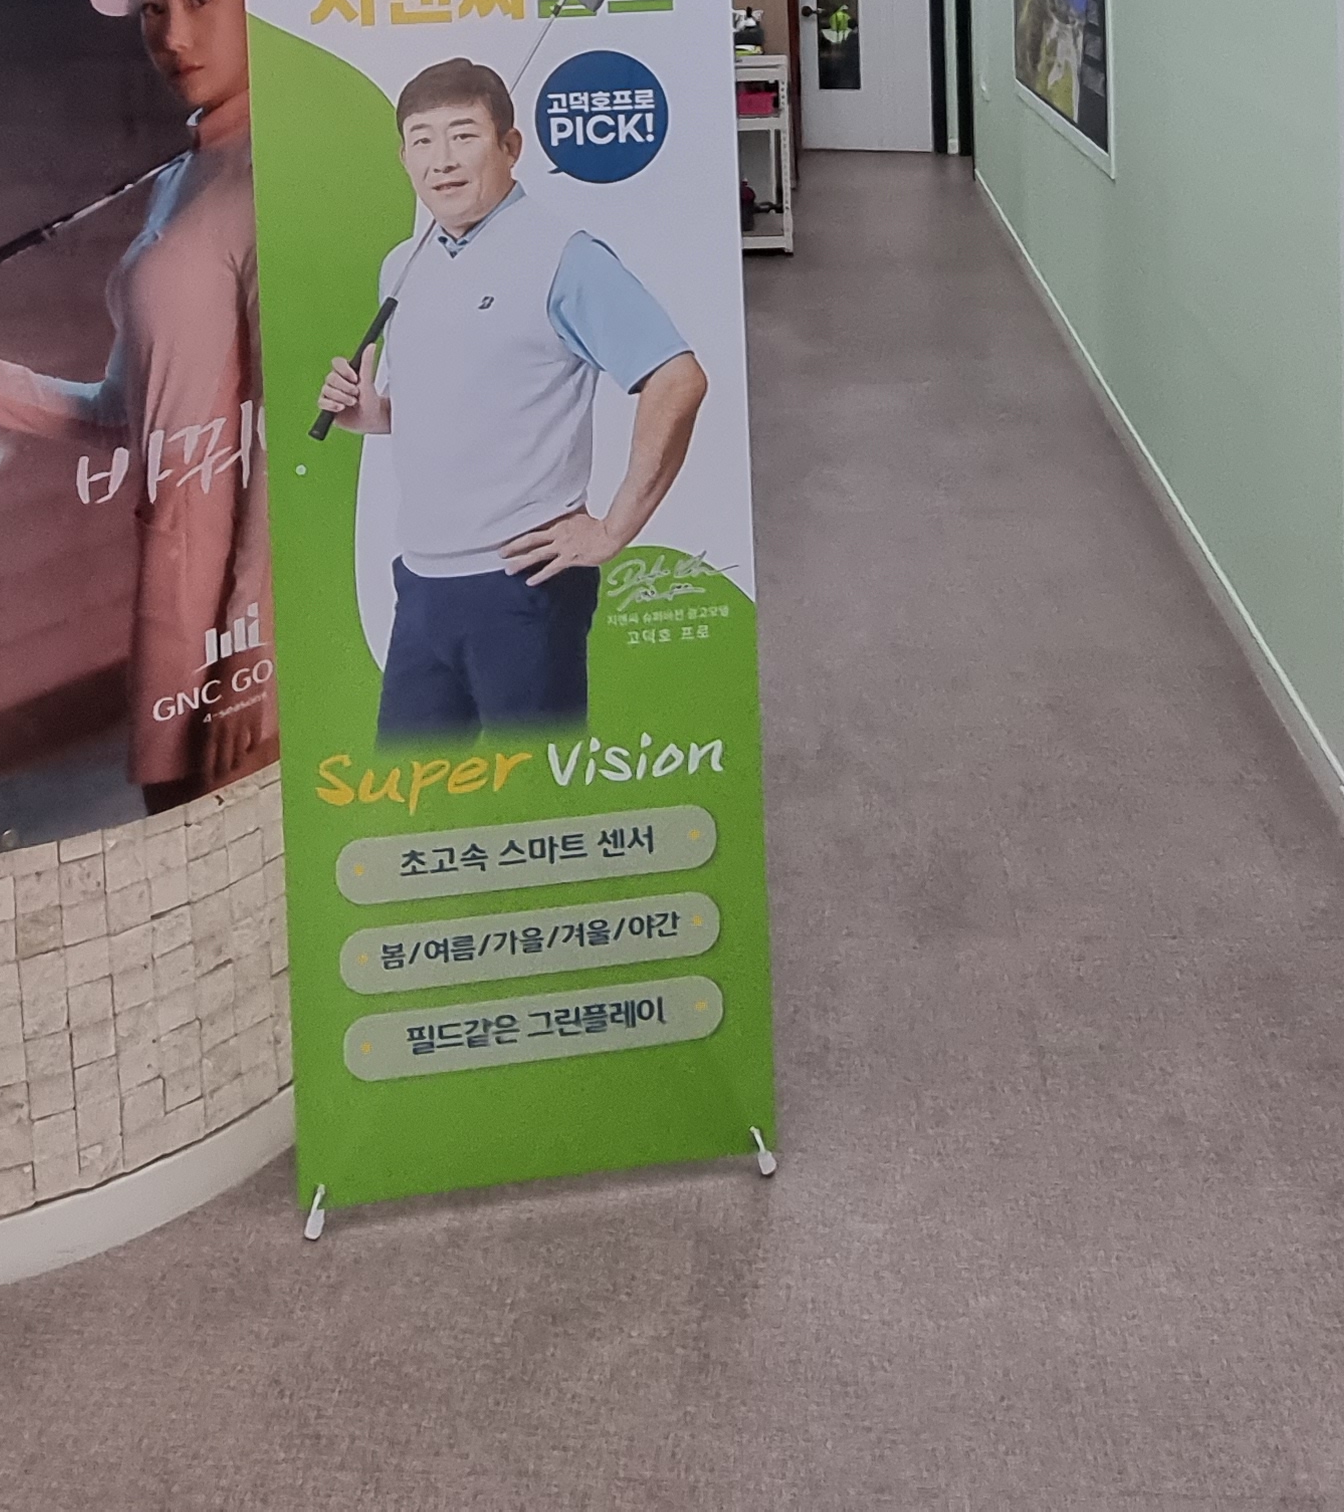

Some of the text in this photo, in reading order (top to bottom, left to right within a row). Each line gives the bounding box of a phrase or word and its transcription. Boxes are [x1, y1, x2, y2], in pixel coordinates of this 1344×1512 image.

[546, 89, 655, 114] 고덕호프로
[550, 113, 655, 146] PICK!
[627, 624, 709, 645] 고덕호 프로
[152, 679, 223, 722] GNC
[315, 731, 725, 816] Super Vision
[399, 824, 655, 878] 초고속 스마트 센서
[380, 910, 681, 971] 봄/여름/가을/겨울/야간
[406, 995, 667, 1056] 필드같은 그린플레이
